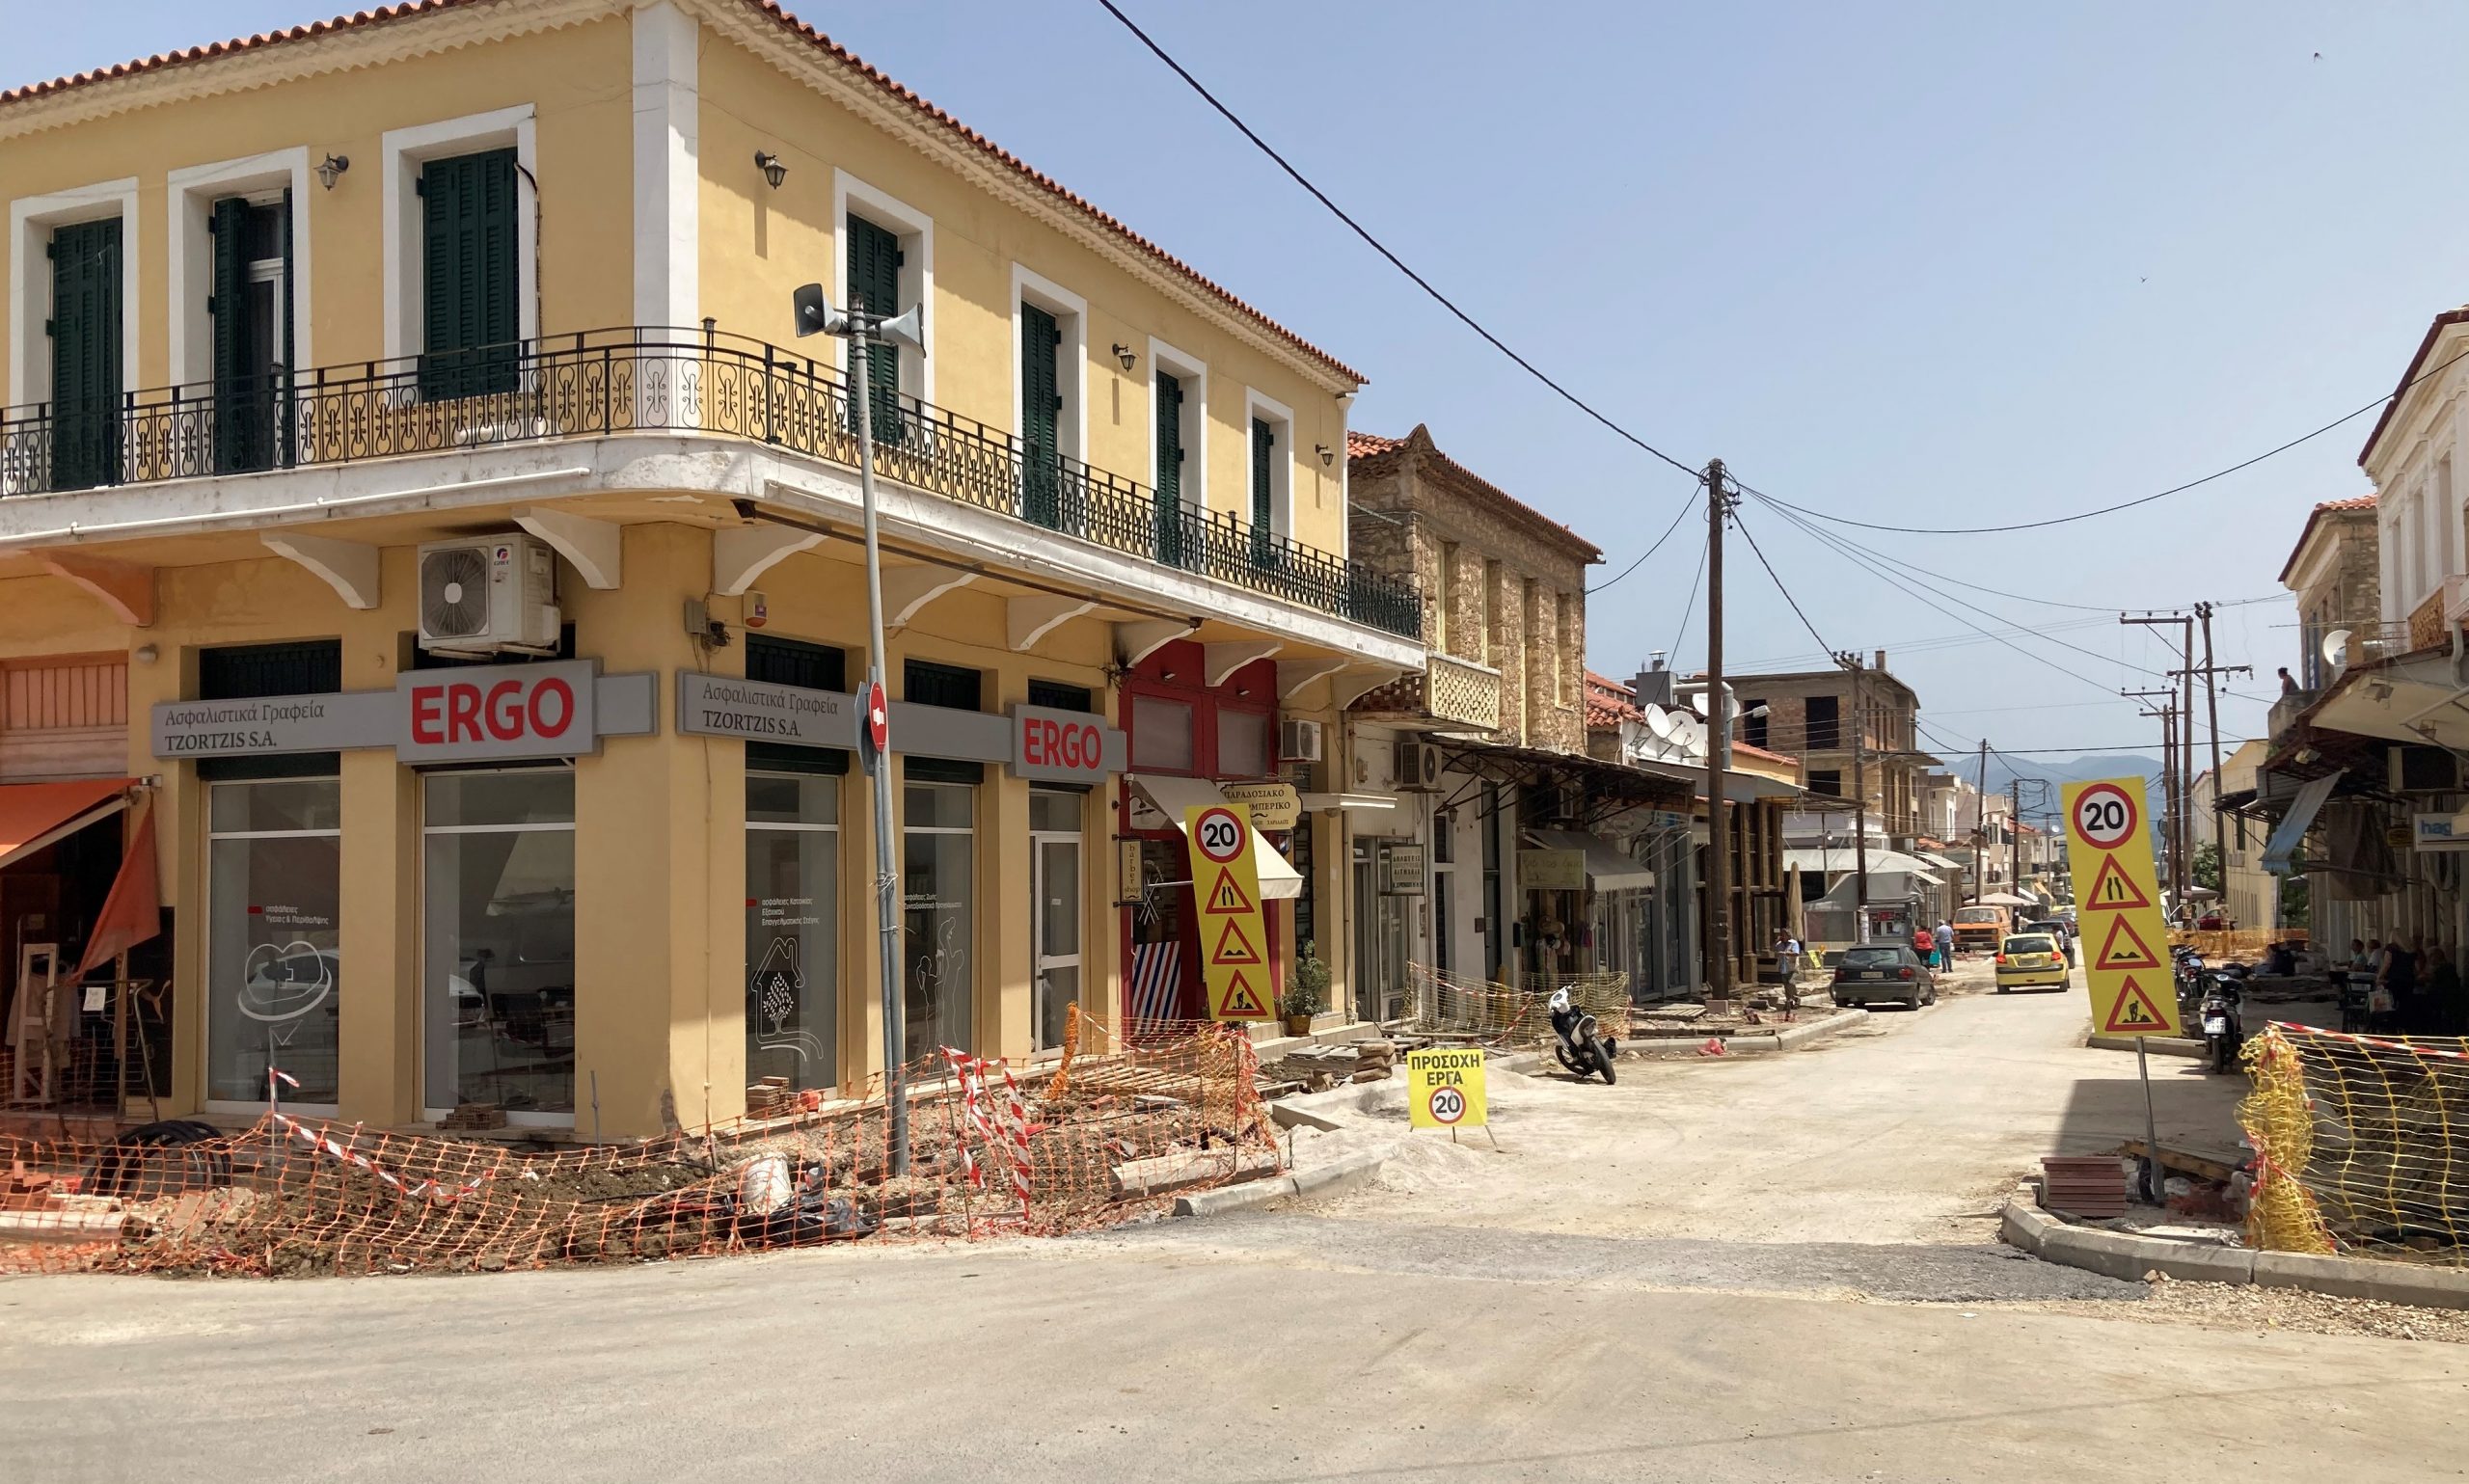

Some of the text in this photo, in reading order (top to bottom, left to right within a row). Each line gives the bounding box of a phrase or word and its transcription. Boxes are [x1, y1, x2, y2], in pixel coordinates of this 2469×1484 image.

[412, 677, 575, 744] ERGO
[702, 682, 838, 716] Ασφαλιστικά Γραφεία
[165, 699, 325, 729] Ασφαλιστικά Γραφεία
[702, 710, 802, 738] TZORTZIS S.A.
[164, 731, 277, 751] TZORTZIS S.A.
[1023, 717, 1102, 769] ERGO
[2084, 800, 2125, 831] 20
[2421, 820, 2453, 836] hag
[1204, 823, 1235, 848] 20
[1411, 1054, 1480, 1070] ΠΡΟΣΟΧΗ
[1427, 1070, 1464, 1087] ΕΡΓΑ
[1434, 1095, 1461, 1114] 20
